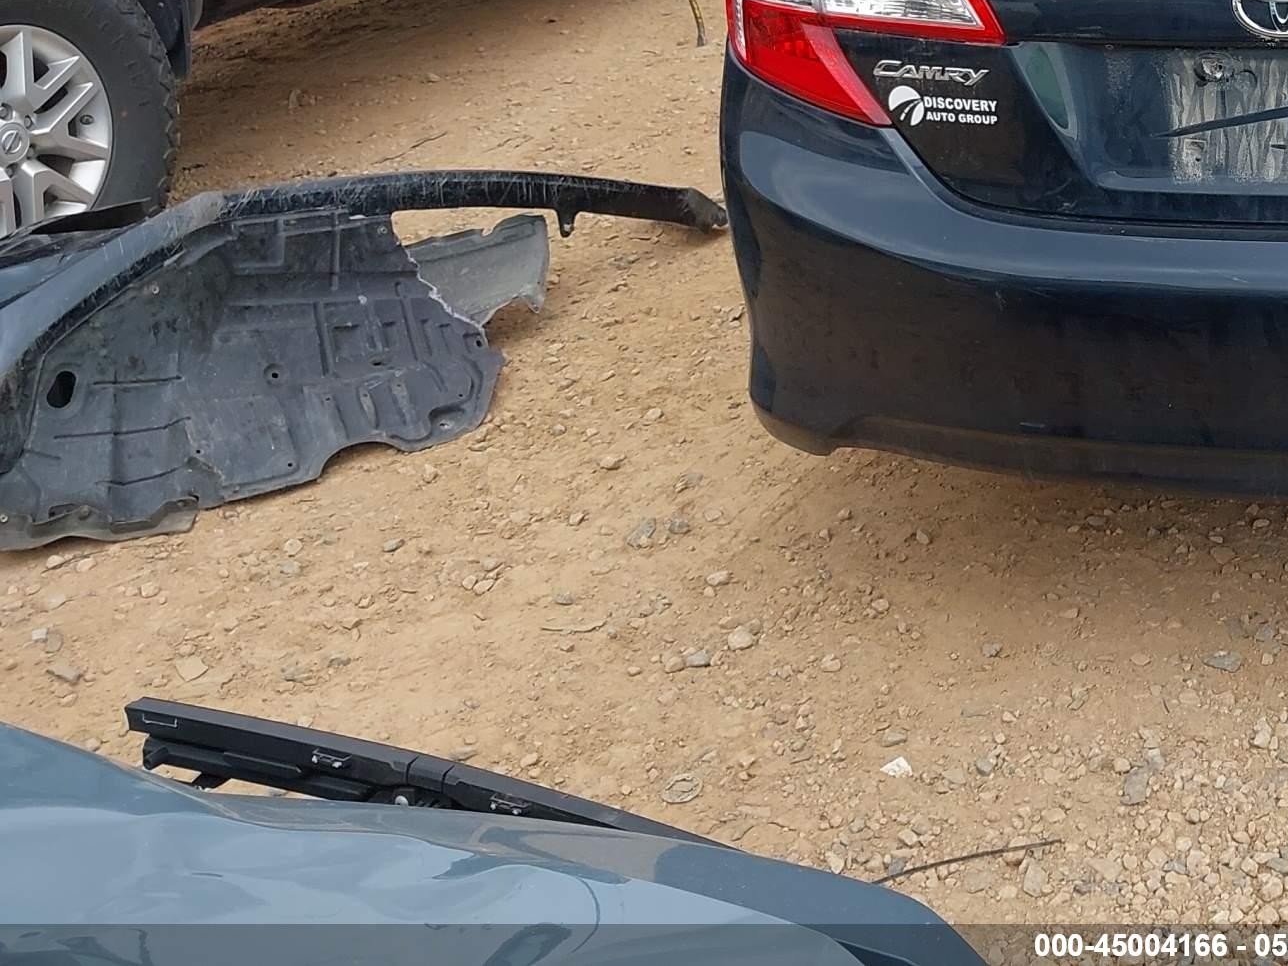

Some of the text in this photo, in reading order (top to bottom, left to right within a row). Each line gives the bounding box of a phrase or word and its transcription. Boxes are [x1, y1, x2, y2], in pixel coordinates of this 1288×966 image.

[873, 60, 990, 86] CAMRY
[923, 96, 998, 112] DISCOVERY
[926, 111, 998, 125] AUTO GROUP
